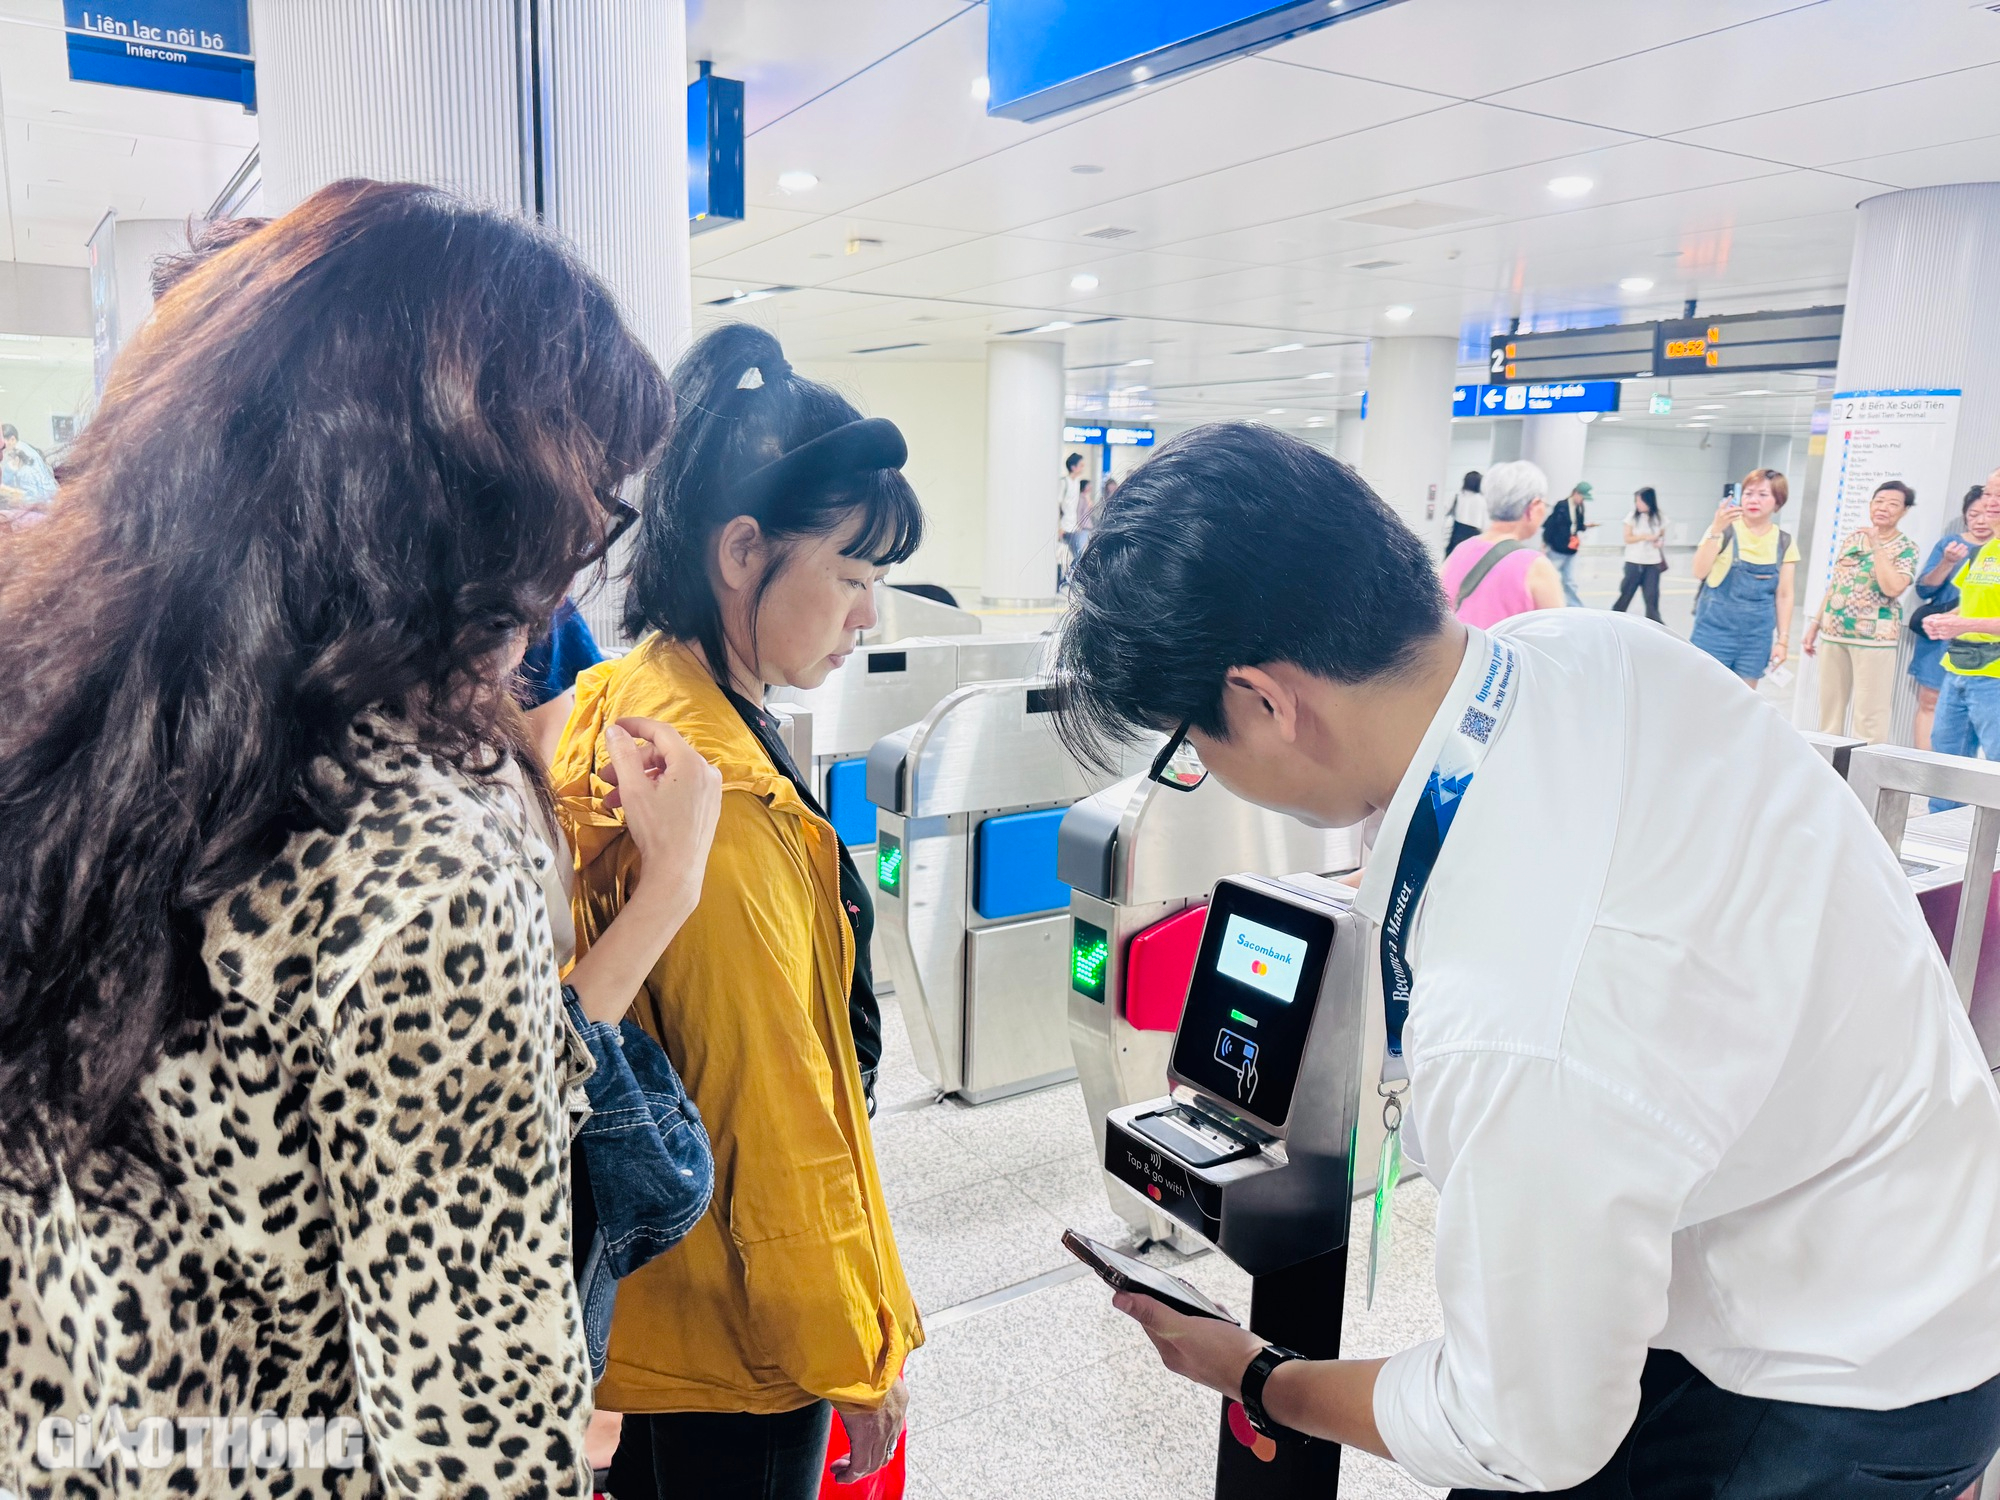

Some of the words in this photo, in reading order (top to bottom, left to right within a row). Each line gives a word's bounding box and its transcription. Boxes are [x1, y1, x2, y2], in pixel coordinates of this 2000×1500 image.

[83, 11, 127, 35] Liên
[126, 42, 187, 64] Intercom
[1491, 348, 1504, 373] 2
[1666, 340, 1705, 358] 09:52
[1846, 403, 1854, 419] 2
[1475, 658, 1502, 703] University
[1387, 881, 1413, 941] Master
[1236, 933, 1292, 965] Sacombank
[1388, 940, 1398, 953] a
[1389, 952, 1411, 1001] Become
[1126, 1150, 1142, 1170] Tap
[1143, 1162, 1151, 1175] &
[1152, 1171, 1164, 1184] go
[1165, 1179, 1185, 1198] with
